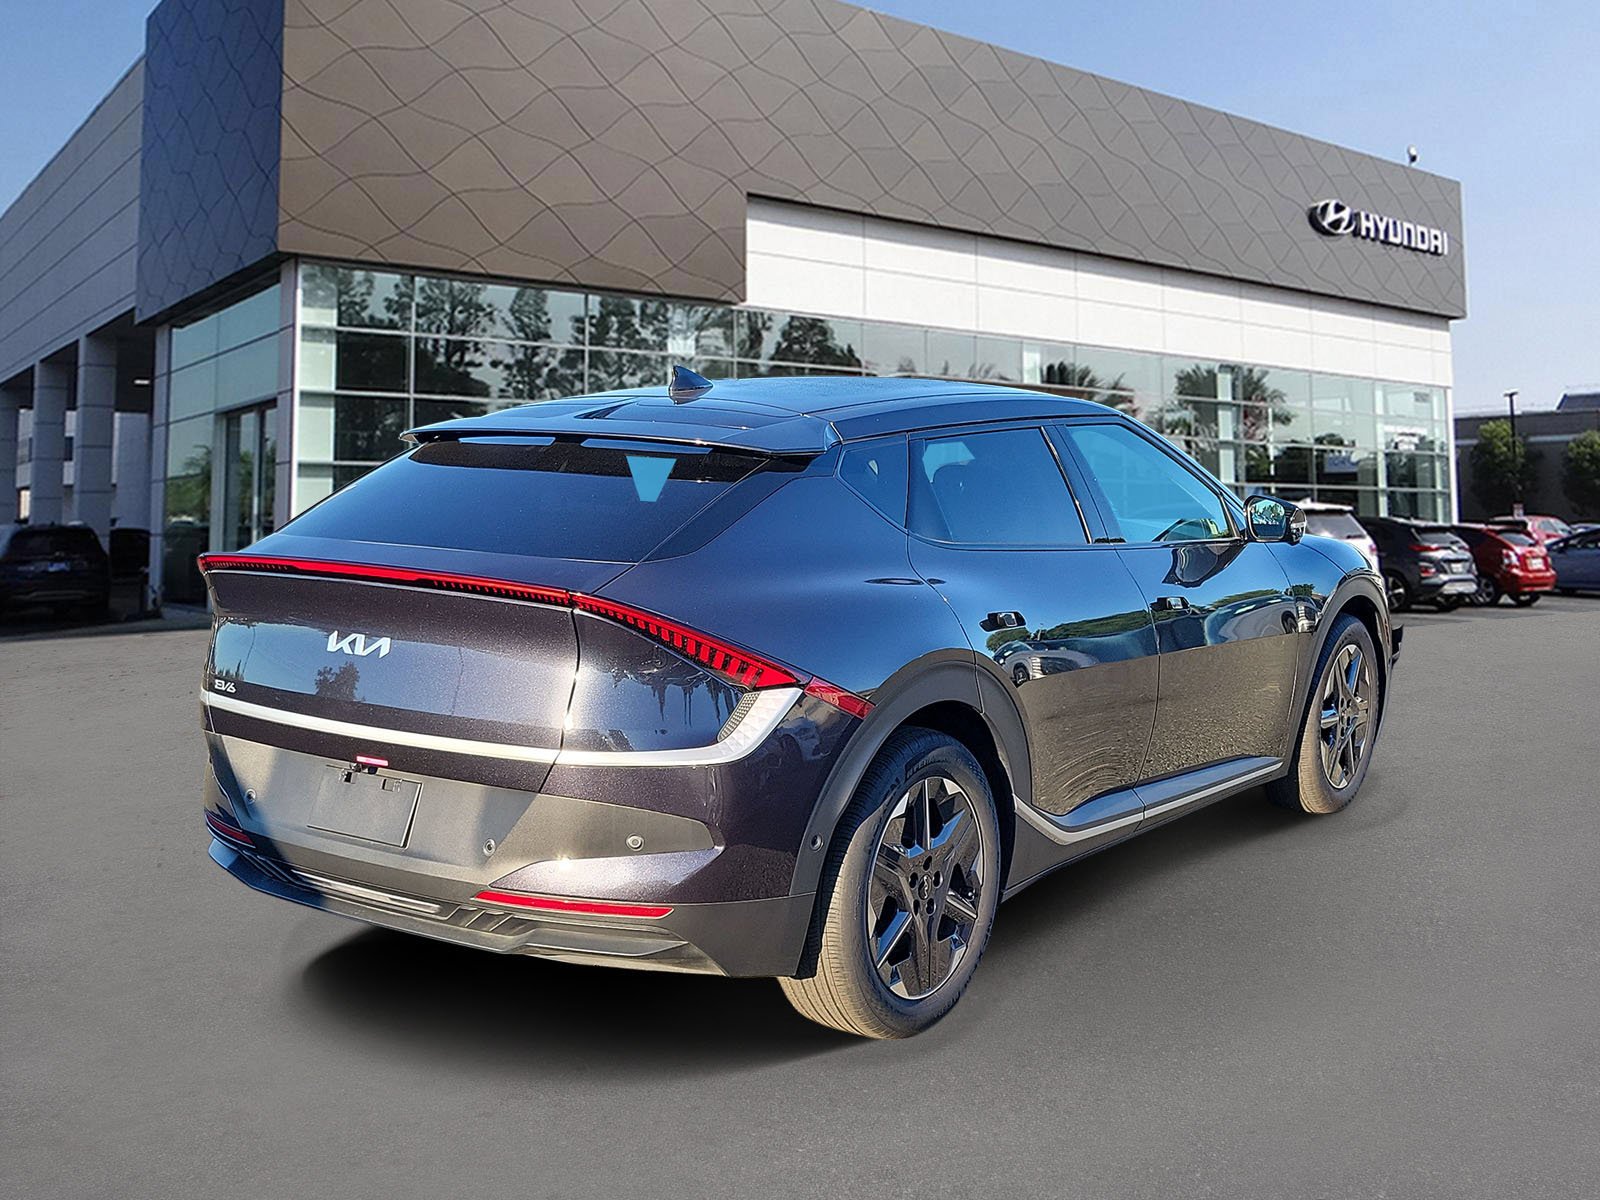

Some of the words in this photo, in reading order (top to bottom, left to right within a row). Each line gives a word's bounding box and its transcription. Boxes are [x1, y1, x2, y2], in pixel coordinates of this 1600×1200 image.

[1360, 211, 1448, 255] HYUNDAI
[326, 630, 391, 658] KIA
[214, 679, 236, 693] EV6
